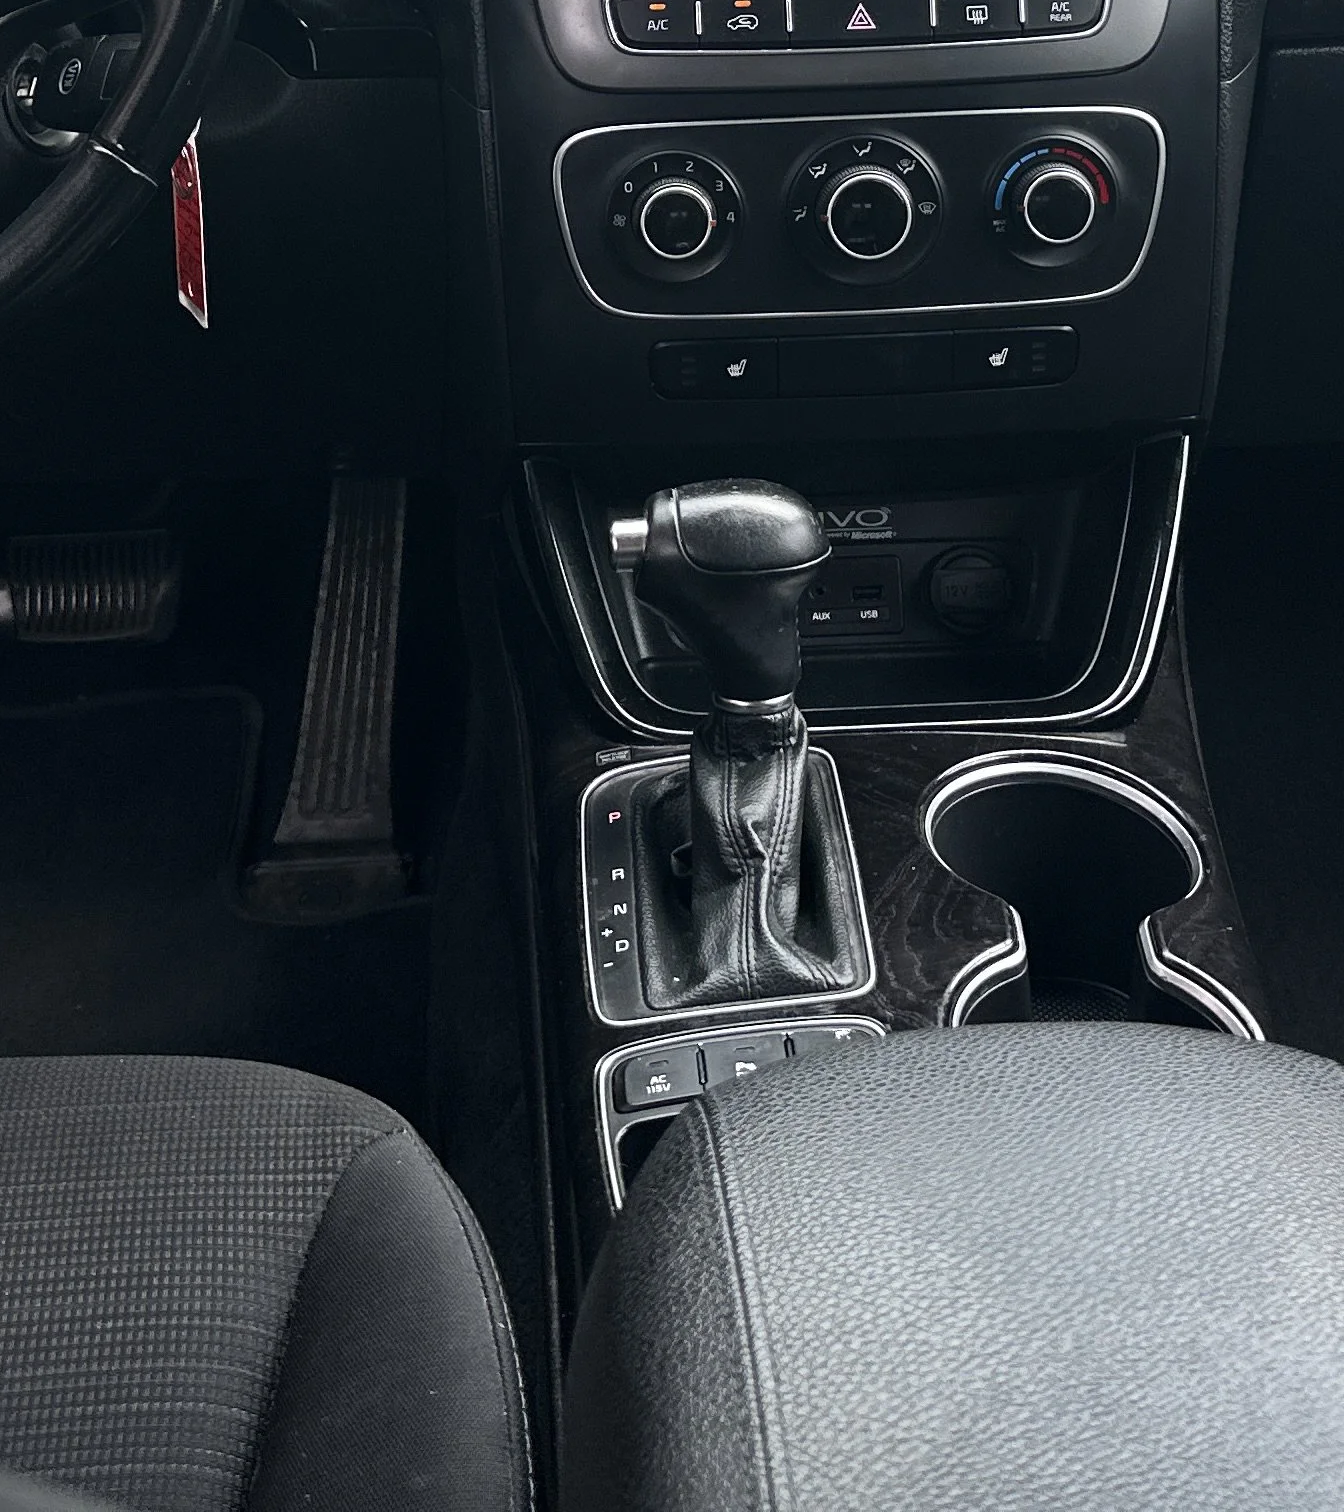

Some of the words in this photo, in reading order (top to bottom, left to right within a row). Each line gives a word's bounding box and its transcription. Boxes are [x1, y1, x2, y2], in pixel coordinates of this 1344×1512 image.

[1051, 1, 1071, 14] A/C
[1049, 13, 1073, 22] REAR
[647, 19, 669, 32] A/C
[653, 161, 659, 174] 1
[685, 160, 695, 173] 2
[715, 179, 725, 192] 3
[726, 211, 736, 224] 4
[812, 611, 831, 621] AUX
[860, 609, 879, 619] USB
[608, 811, 621, 824] P
[611, 868, 625, 881] R
[613, 903, 628, 916] N
[615, 939, 630, 953] D
[649, 1074, 668, 1085] AC
[646, 1084, 671, 1094] 115V
